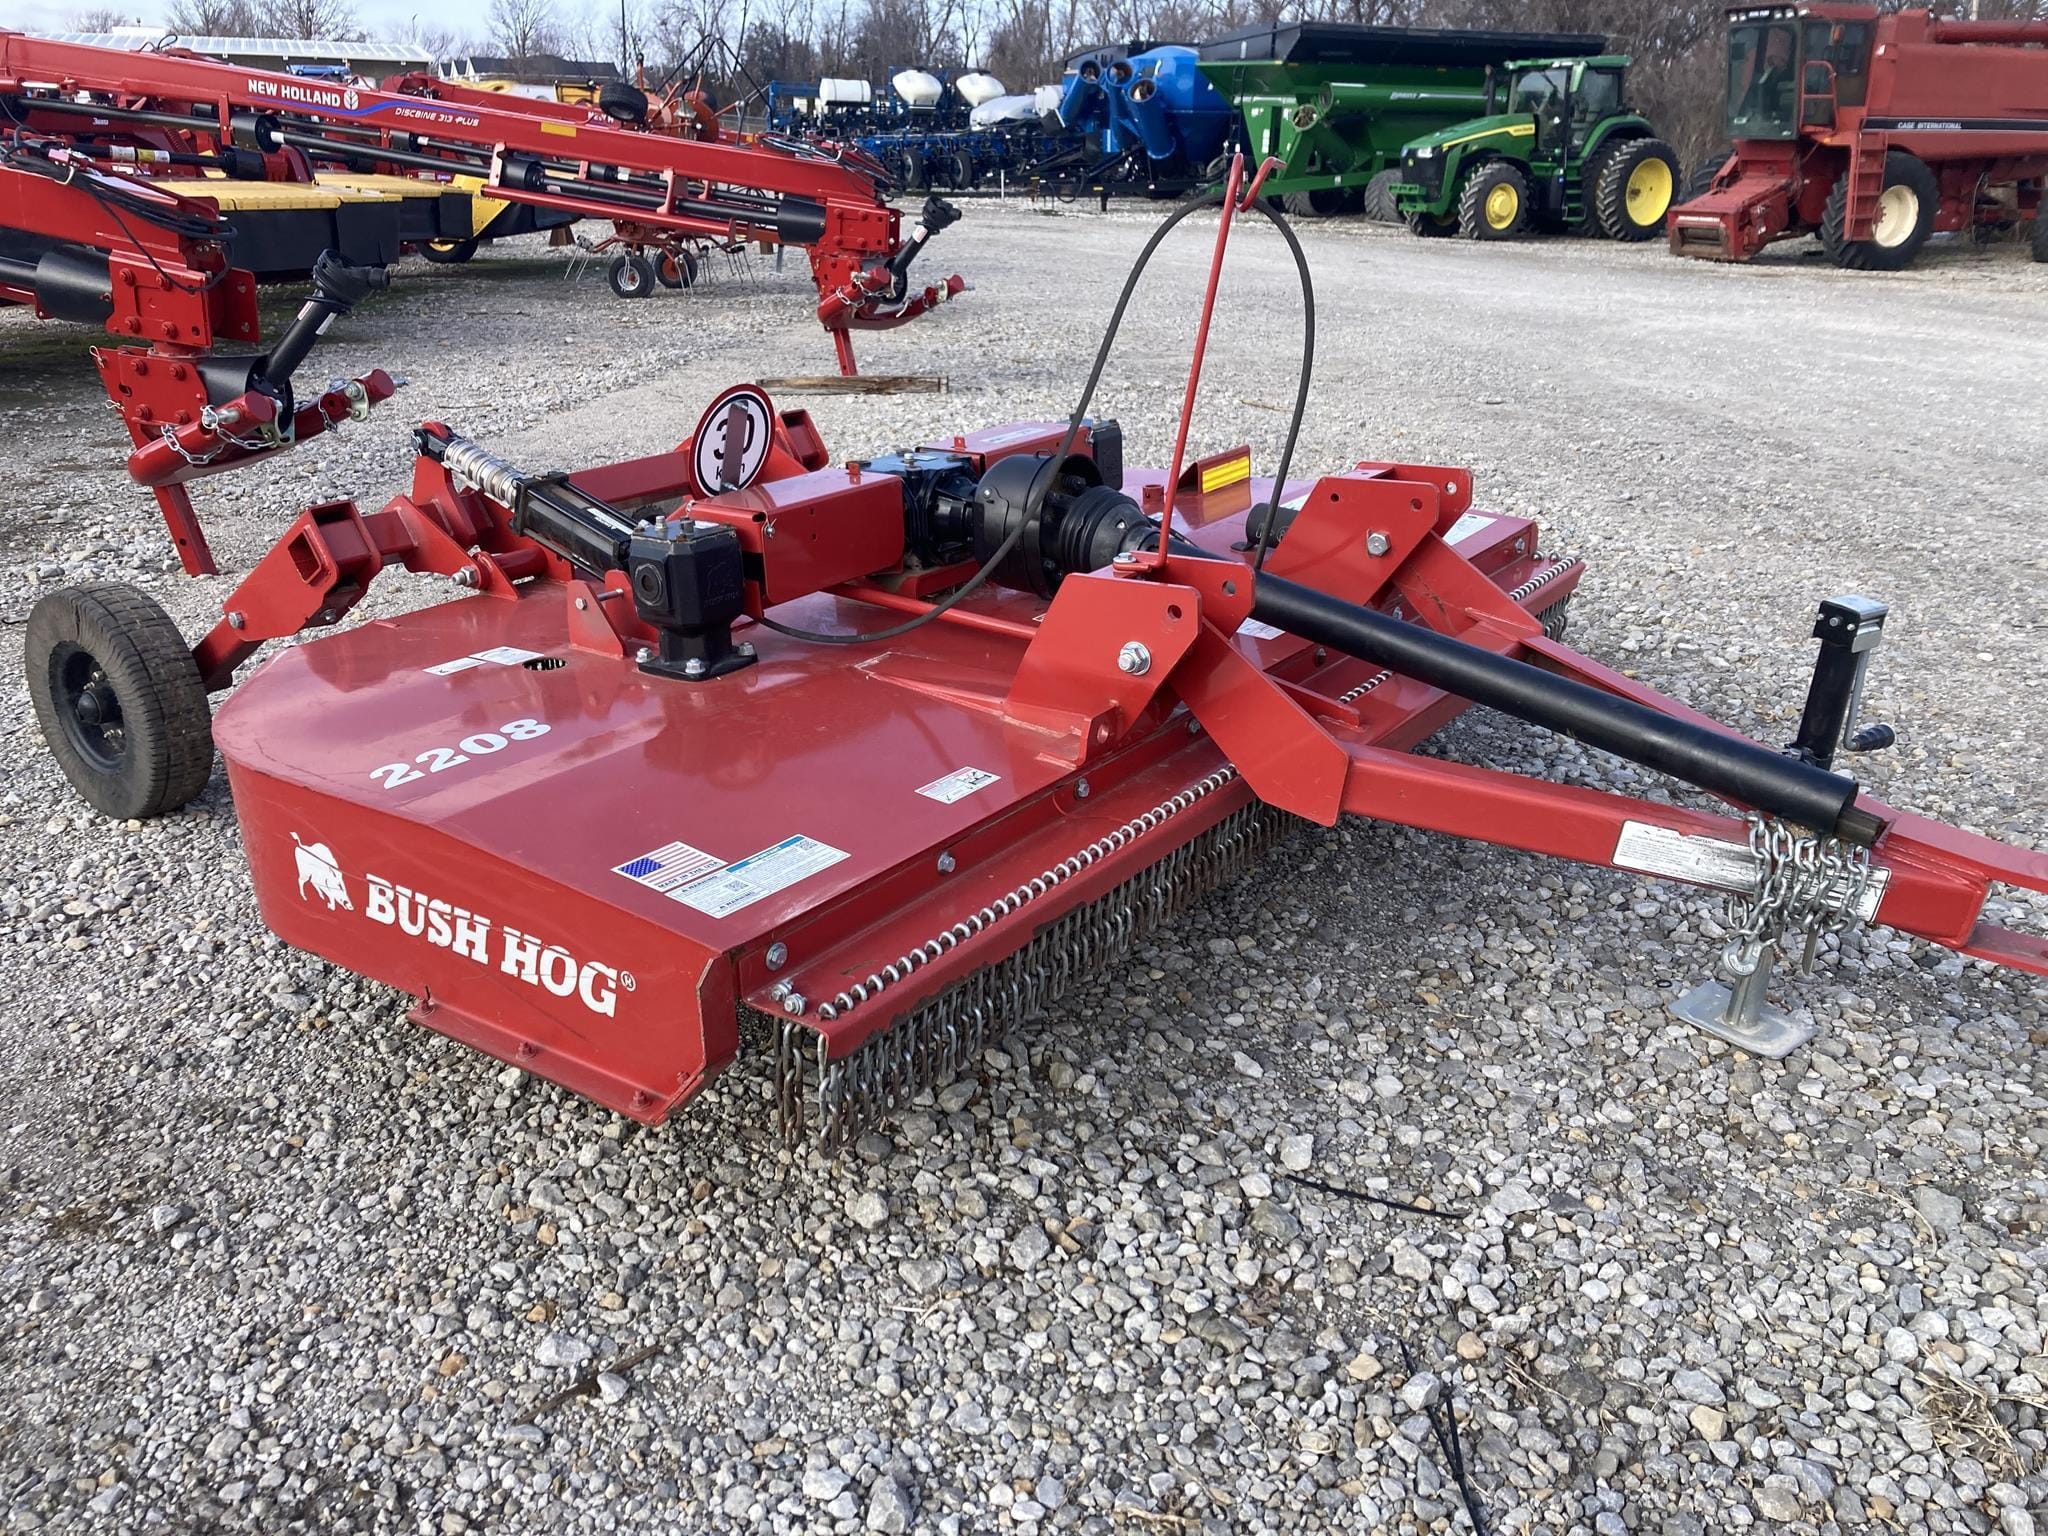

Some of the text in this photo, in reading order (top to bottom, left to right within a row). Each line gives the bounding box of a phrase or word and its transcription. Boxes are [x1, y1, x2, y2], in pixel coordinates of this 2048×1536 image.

[248, 79, 341, 107] NEW HOLLAND
[395, 107, 437, 121] DISCBINE
[438, 113, 453, 123] 313
[1897, 121, 1962, 129] CASE INTERNATIONAL
[369, 718, 552, 790] 2208
[658, 878, 679, 889] MADE
[704, 860, 719, 870] USA
[365, 873, 491, 965] BUSH
